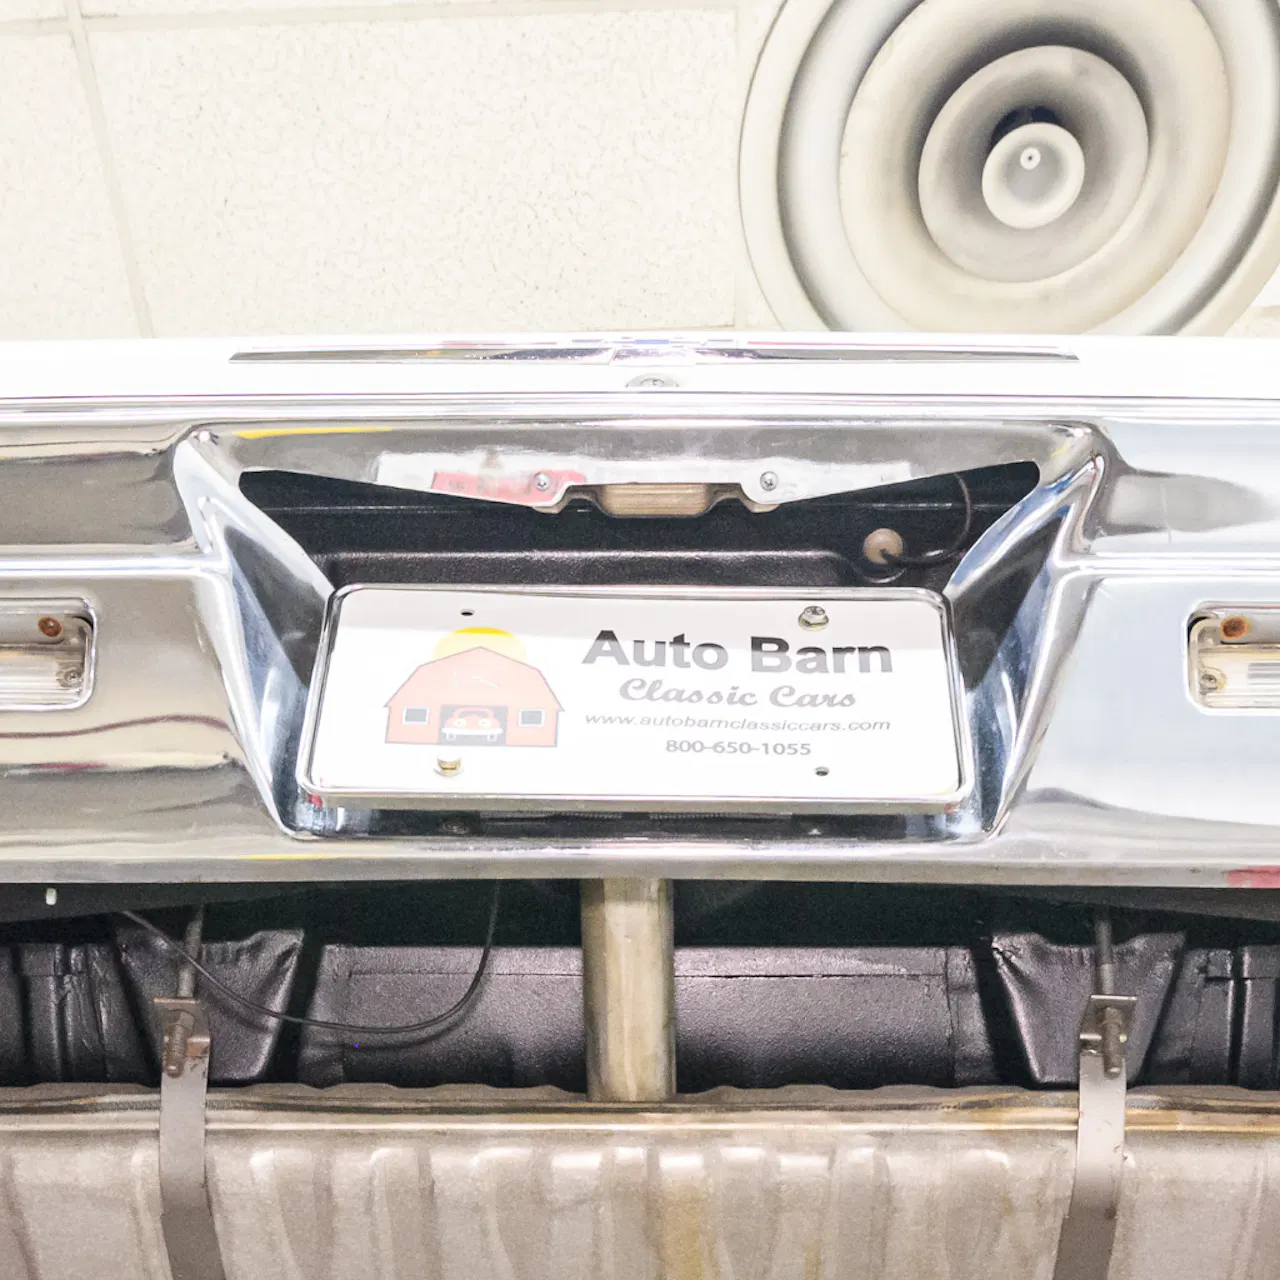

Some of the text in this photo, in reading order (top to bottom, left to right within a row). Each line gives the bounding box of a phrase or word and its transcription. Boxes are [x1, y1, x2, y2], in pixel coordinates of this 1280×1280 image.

[581, 629, 894, 674] Auto Barn
[619, 677, 857, 709] Classic Cars
[584, 713, 892, 732] www.autobarnclassiccars.com
[665, 739, 812, 757] 800-650-1055
